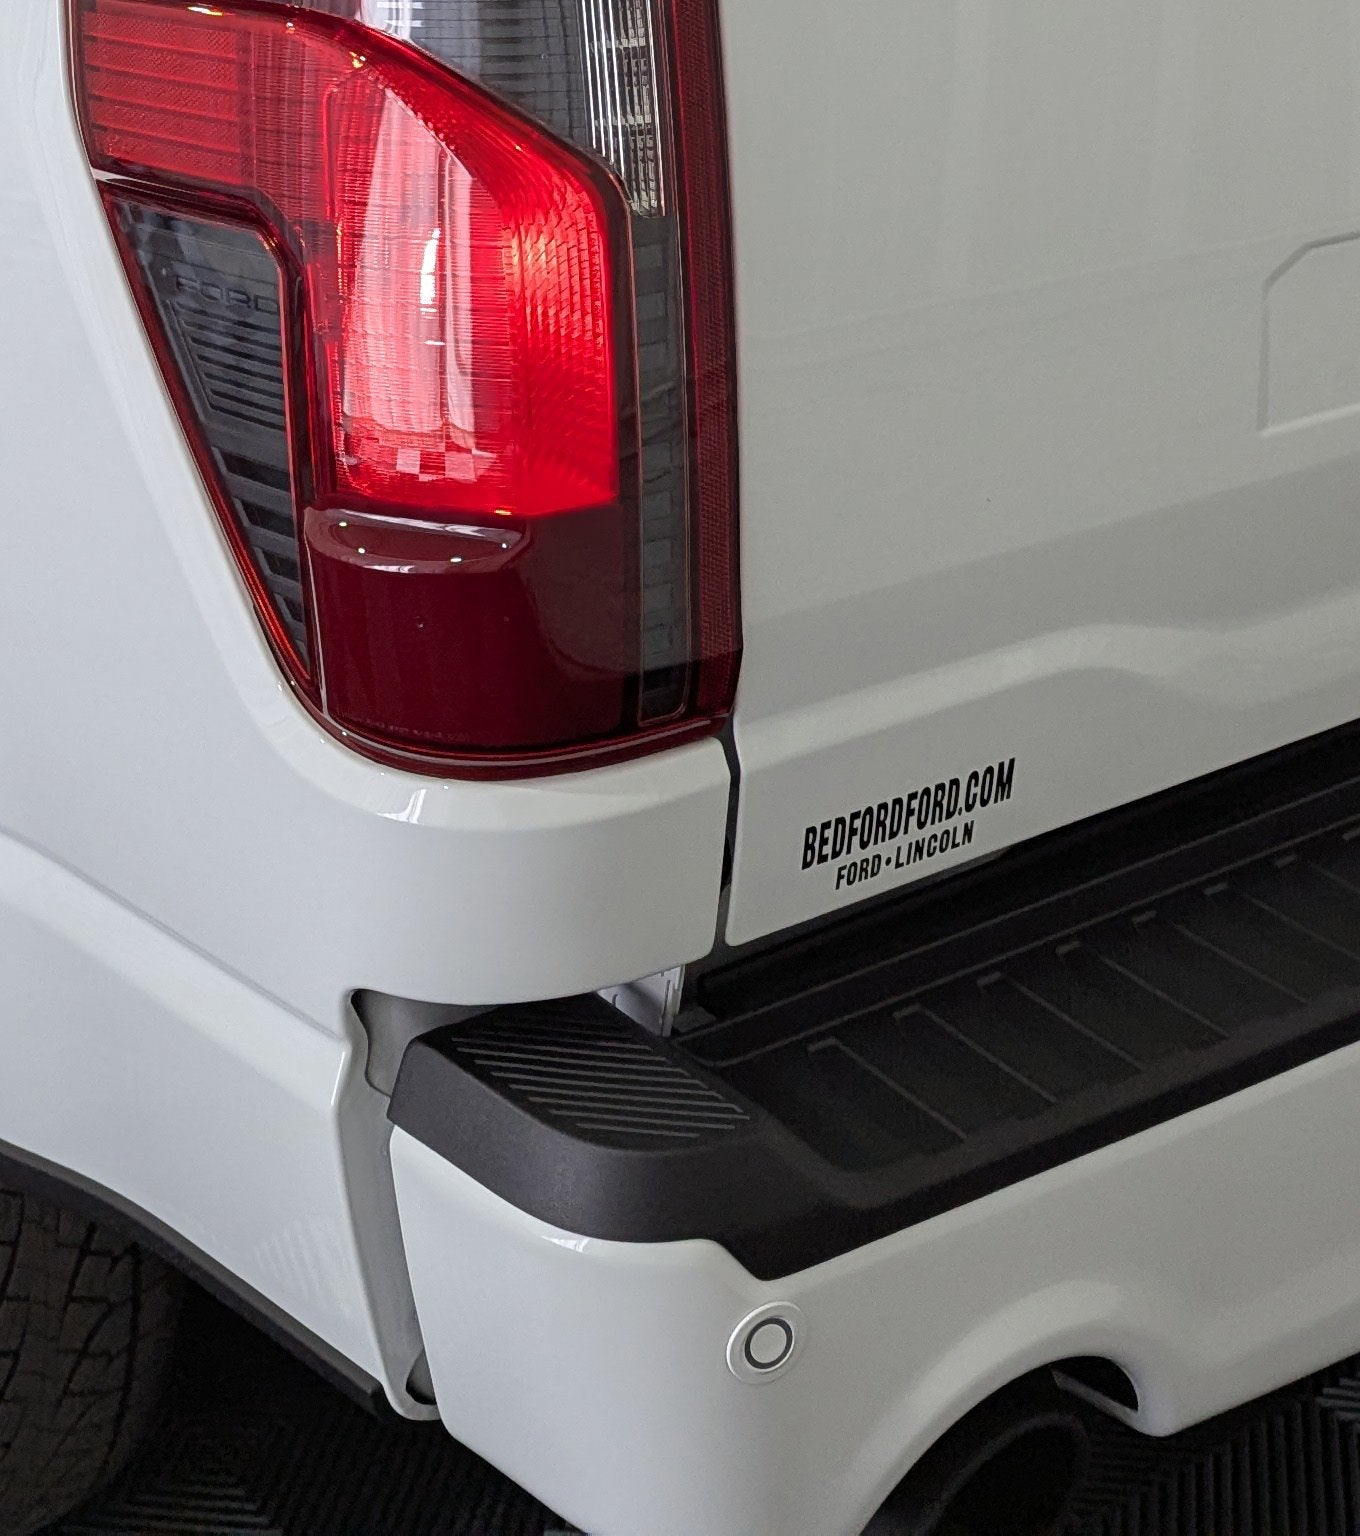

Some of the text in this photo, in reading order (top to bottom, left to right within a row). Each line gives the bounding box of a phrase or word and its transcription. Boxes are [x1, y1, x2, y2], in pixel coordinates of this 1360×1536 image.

[801, 756, 1016, 870] BEDFORDFORD.COM
[835, 819, 975, 890] FORD LINCOLN
